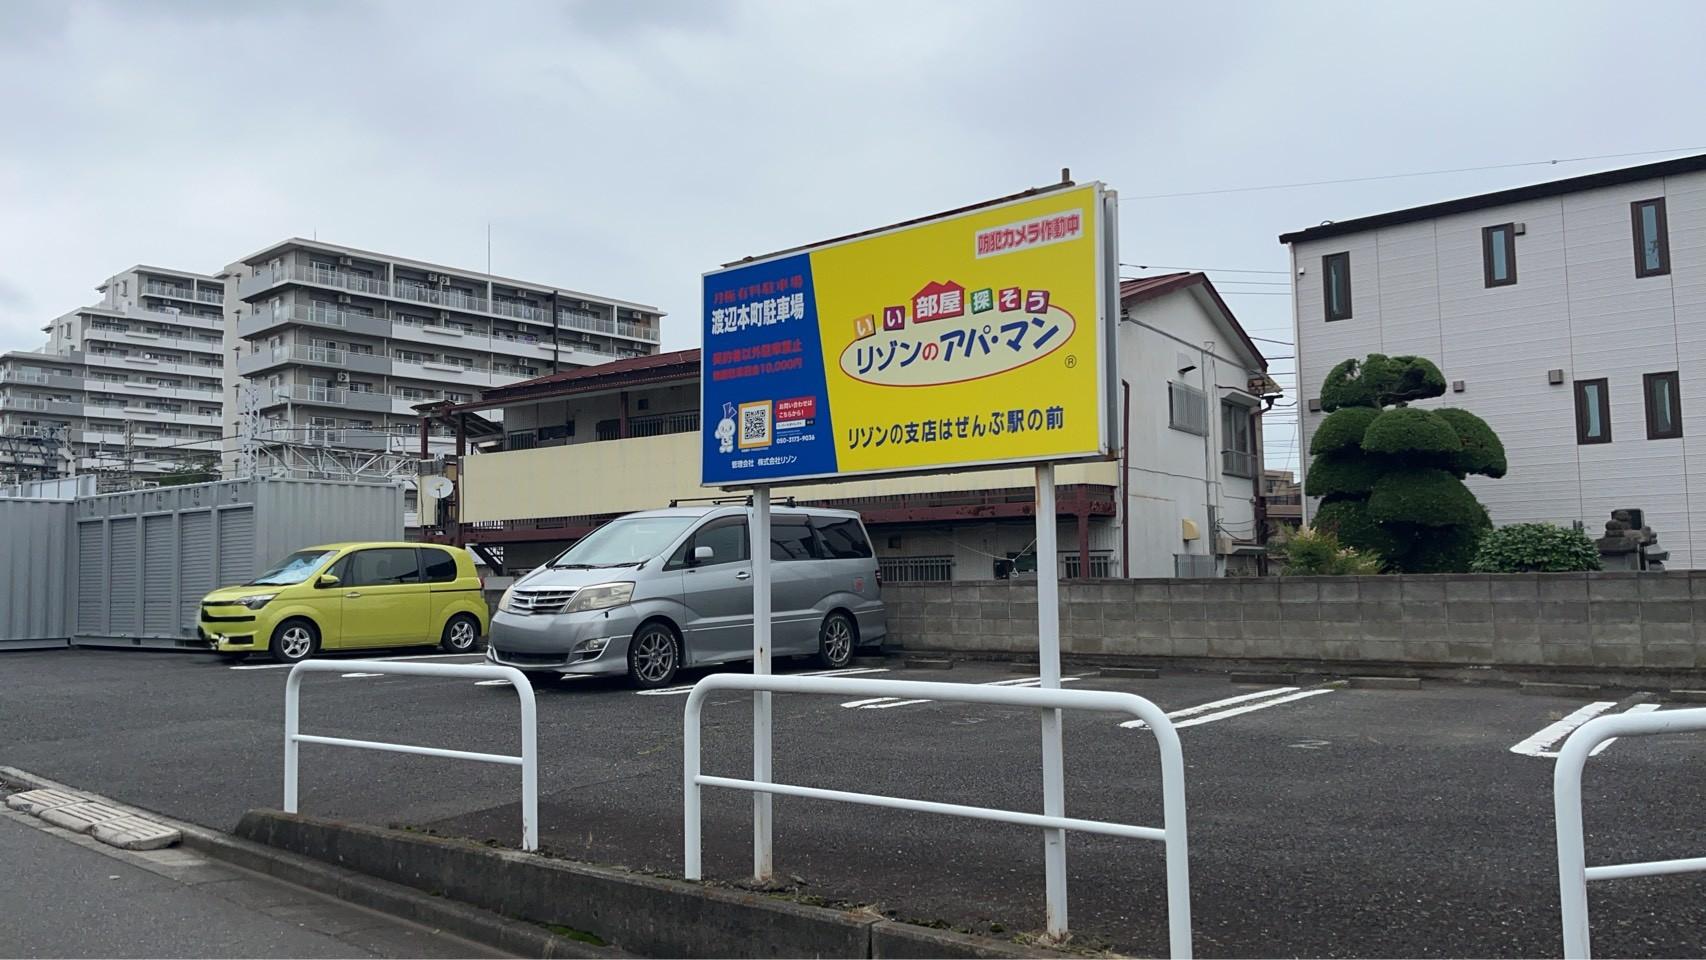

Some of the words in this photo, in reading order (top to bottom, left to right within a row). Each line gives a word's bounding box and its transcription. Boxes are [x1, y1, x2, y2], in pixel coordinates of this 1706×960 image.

[977, 214, 1080, 255] 防犯カメラ作動中
[855, 288, 1045, 335] いい部屋探そう
[848, 405, 1064, 450] リゾンの支店はぜんぶ駅の前
[731, 459, 754, 469] 管理会社
[757, 455, 797, 466] 株式会社リゾン
